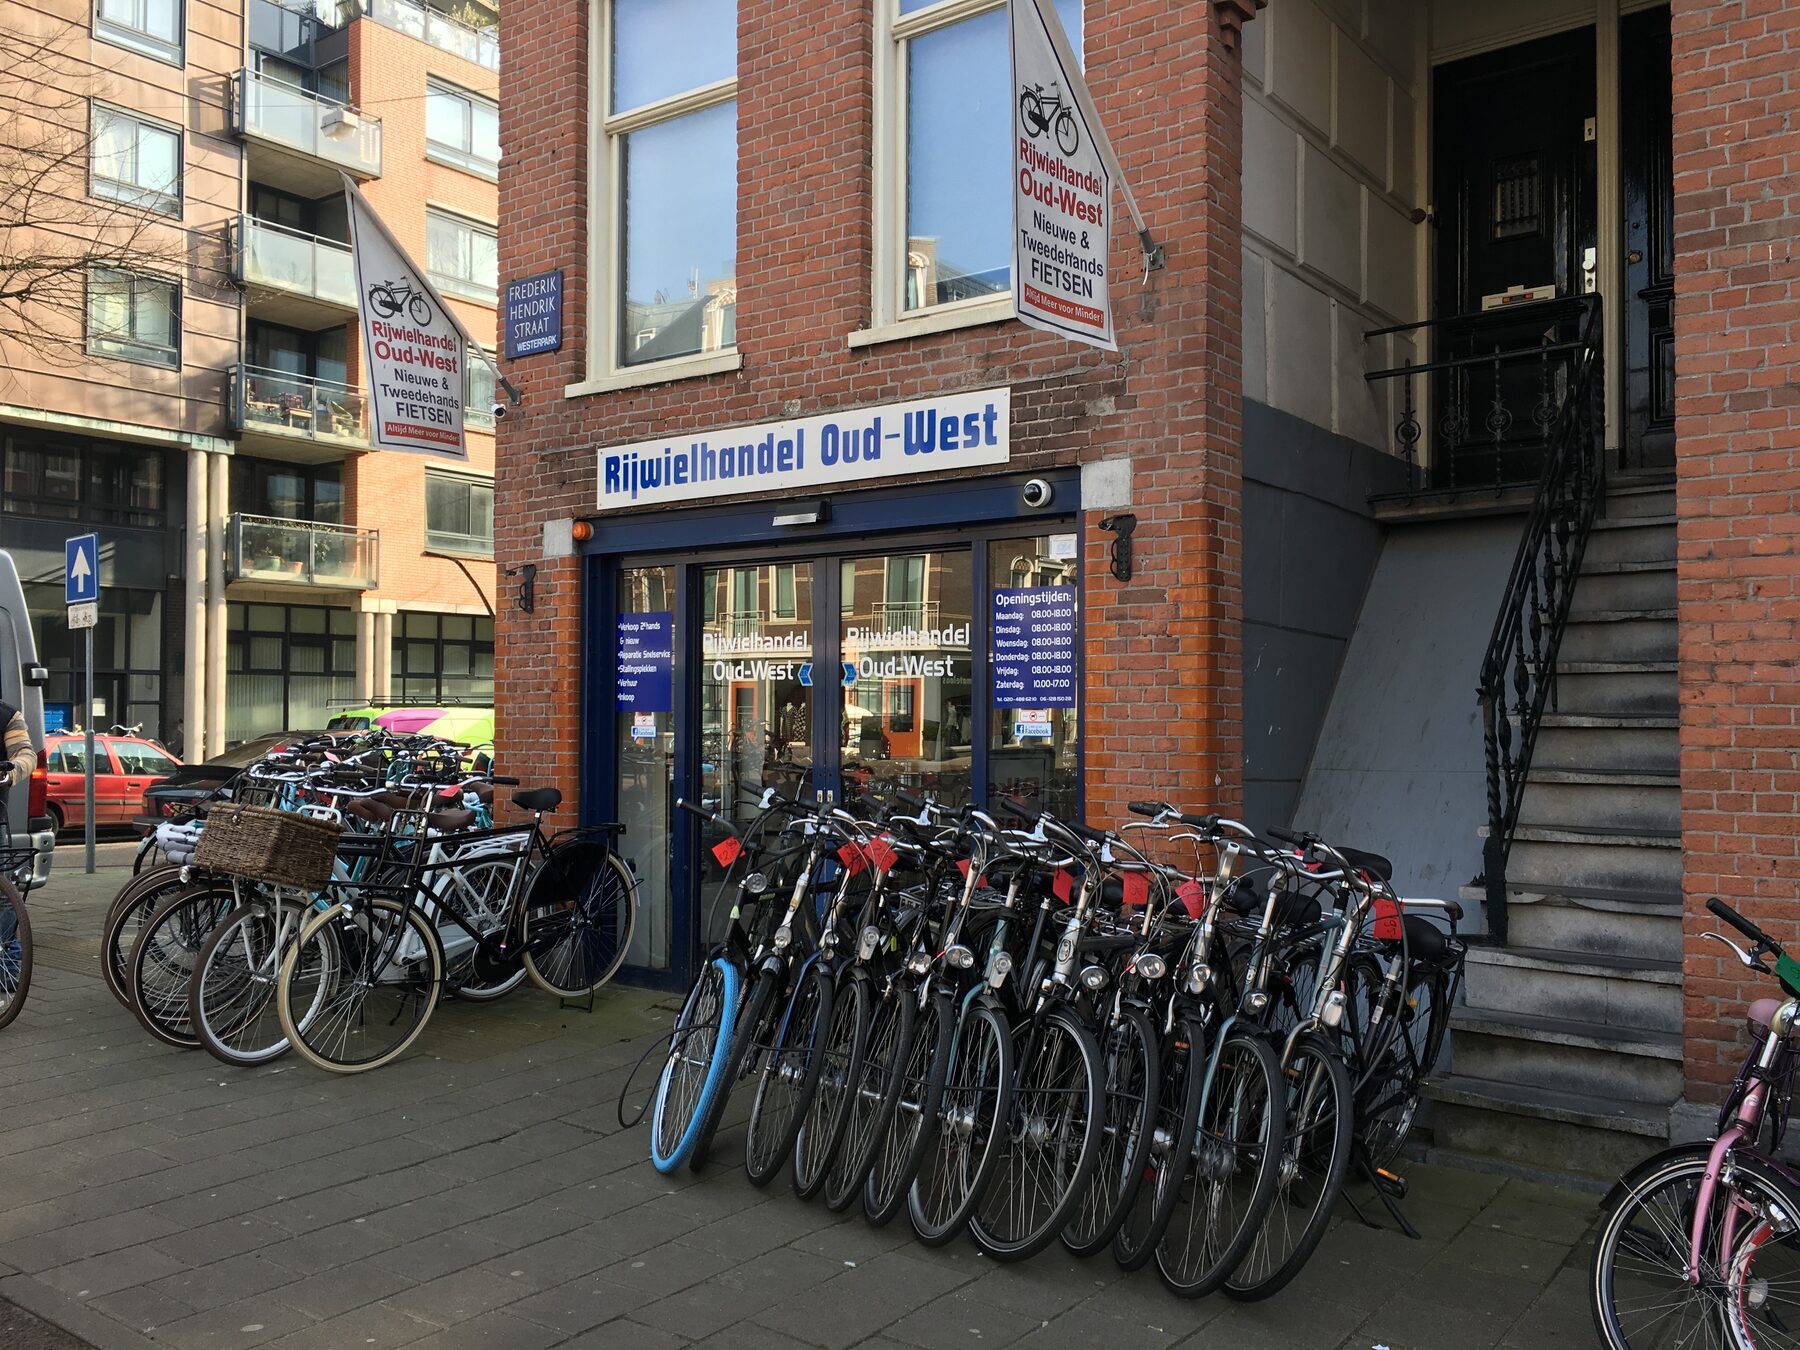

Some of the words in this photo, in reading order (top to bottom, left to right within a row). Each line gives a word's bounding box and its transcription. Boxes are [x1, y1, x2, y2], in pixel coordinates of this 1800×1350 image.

[1019, 167, 1103, 228] Oud-West
[1033, 210, 1077, 245] Nieuwe
[1080, 230, 1090, 250] &
[1020, 229, 1104, 278] Tweedehands
[509, 276, 557, 302] FREDERIK
[1031, 258, 1093, 299] FIETSEN
[510, 296, 555, 321] HENDRIK
[1042, 294, 1058, 310] Meer
[1058, 301, 1074, 314] voor
[514, 317, 550, 339] STRAAT
[517, 335, 557, 352] WESTERPARK
[374, 341, 458, 374] Oud-West
[394, 368, 438, 388] Nieuwe
[441, 379, 449, 390] &
[380, 383, 460, 410] Tweedehands
[396, 401, 453, 426] FIETSEN
[387, 424, 407, 434] Altijd
[408, 426, 424, 437] Meer
[425, 430, 439, 438] voor
[605, 428, 804, 500] Rijwielhandel
[820, 403, 998, 467] Oud-West
[995, 591, 1072, 608] Openingstijden:
[995, 611, 1025, 621] Maandag:
[1031, 608, 1072, 619] 08.00-18.00
[847, 622, 970, 652] Rijwielhandel
[995, 625, 1021, 635] Dinsdag:
[1031, 622, 1072, 633] 08.00-18.00
[702, 630, 808, 657] Rijwielhandel
[996, 639, 1029, 649] Woensdag:
[1031, 636, 1072, 646] 08.00-18.00
[859, 655, 954, 678] Oud-West
[995, 652, 1030, 662] Donderdag:
[1031, 650, 1072, 660] 08.00-18.00
[713, 660, 794, 681] Oud-West
[996, 666, 1019, 677] Vrijdag:
[1031, 664, 1072, 674] 08.00-18.00
[995, 680, 1025, 690] Zaterdag:
[1033, 679, 1070, 688] 10.00-17.00
